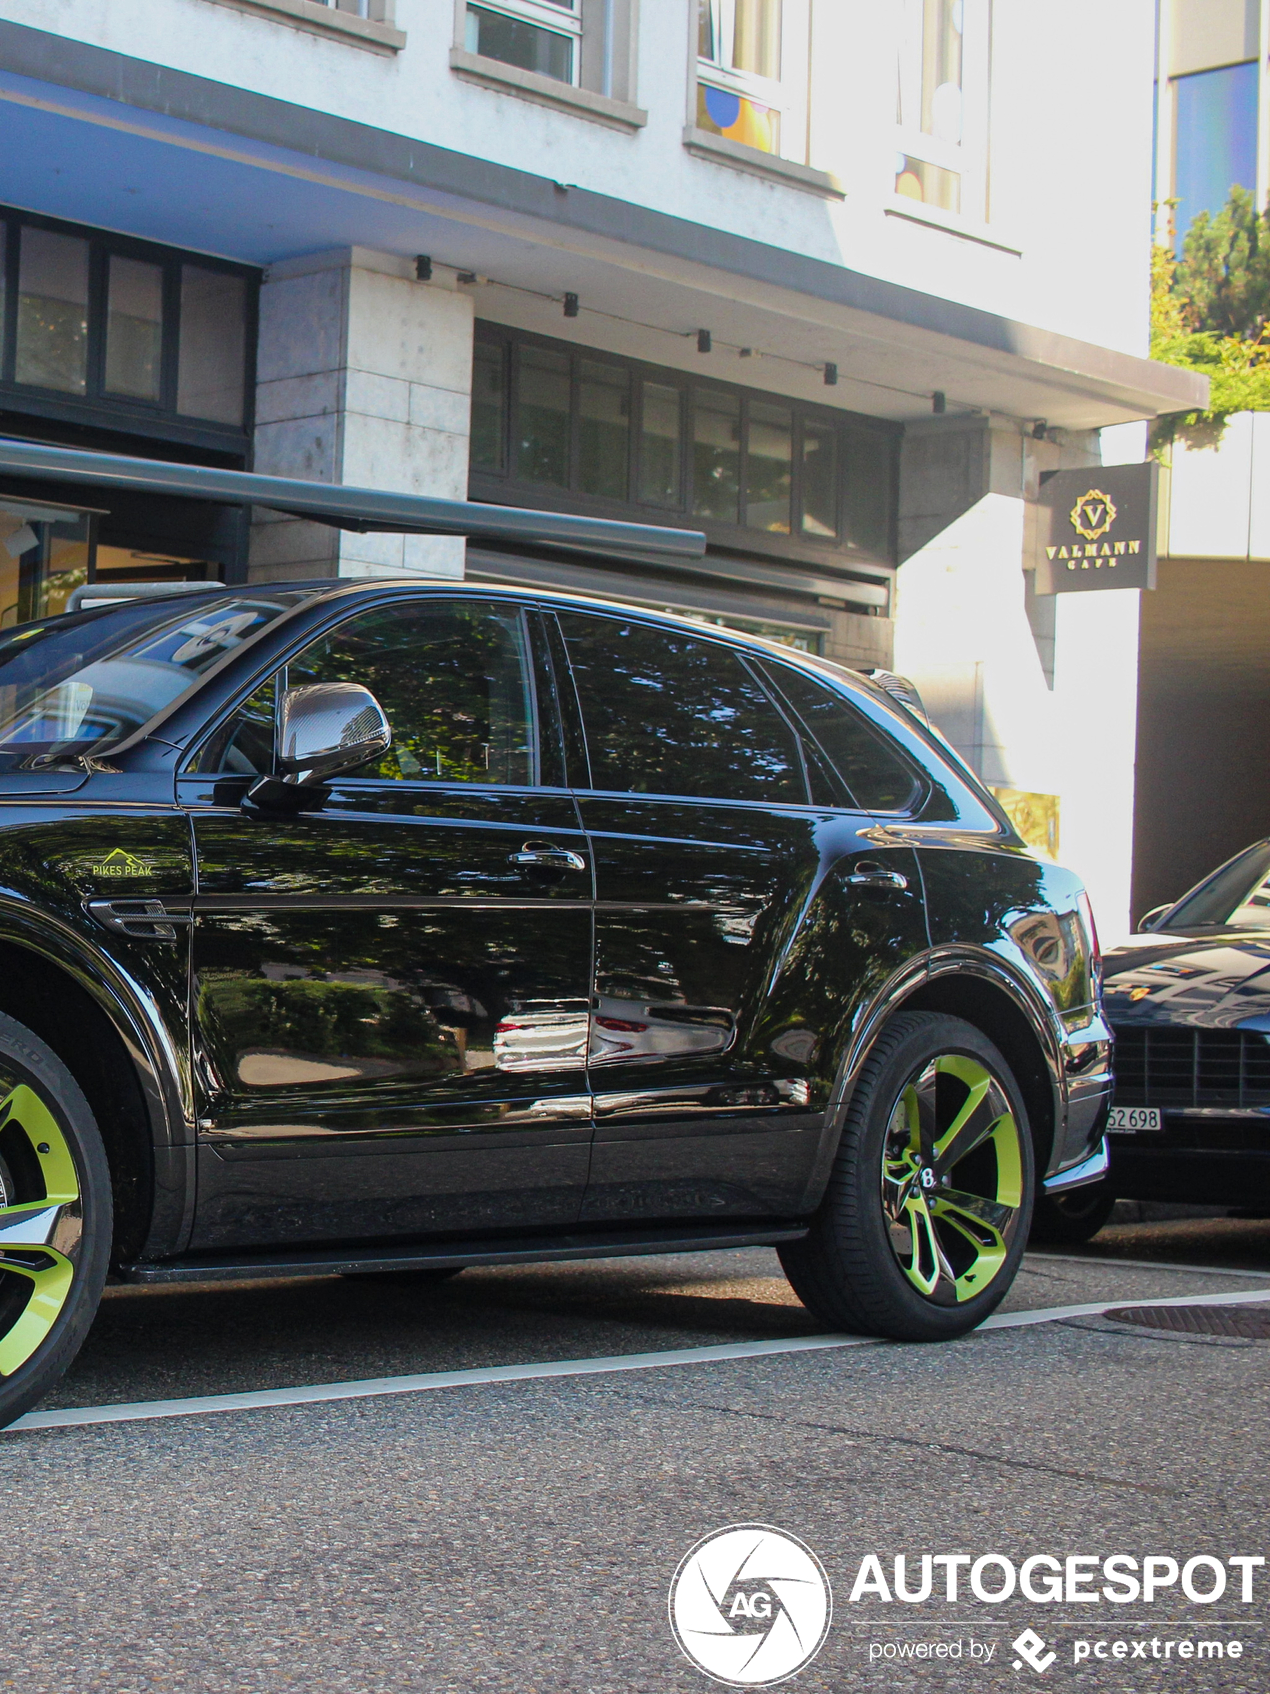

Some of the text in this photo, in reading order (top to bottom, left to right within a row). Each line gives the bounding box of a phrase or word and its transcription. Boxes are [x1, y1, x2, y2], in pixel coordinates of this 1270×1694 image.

[1083, 504, 1105, 527] V
[1045, 540, 1141, 560] VALMANN
[92, 865, 152, 876] PIKES PEAK
